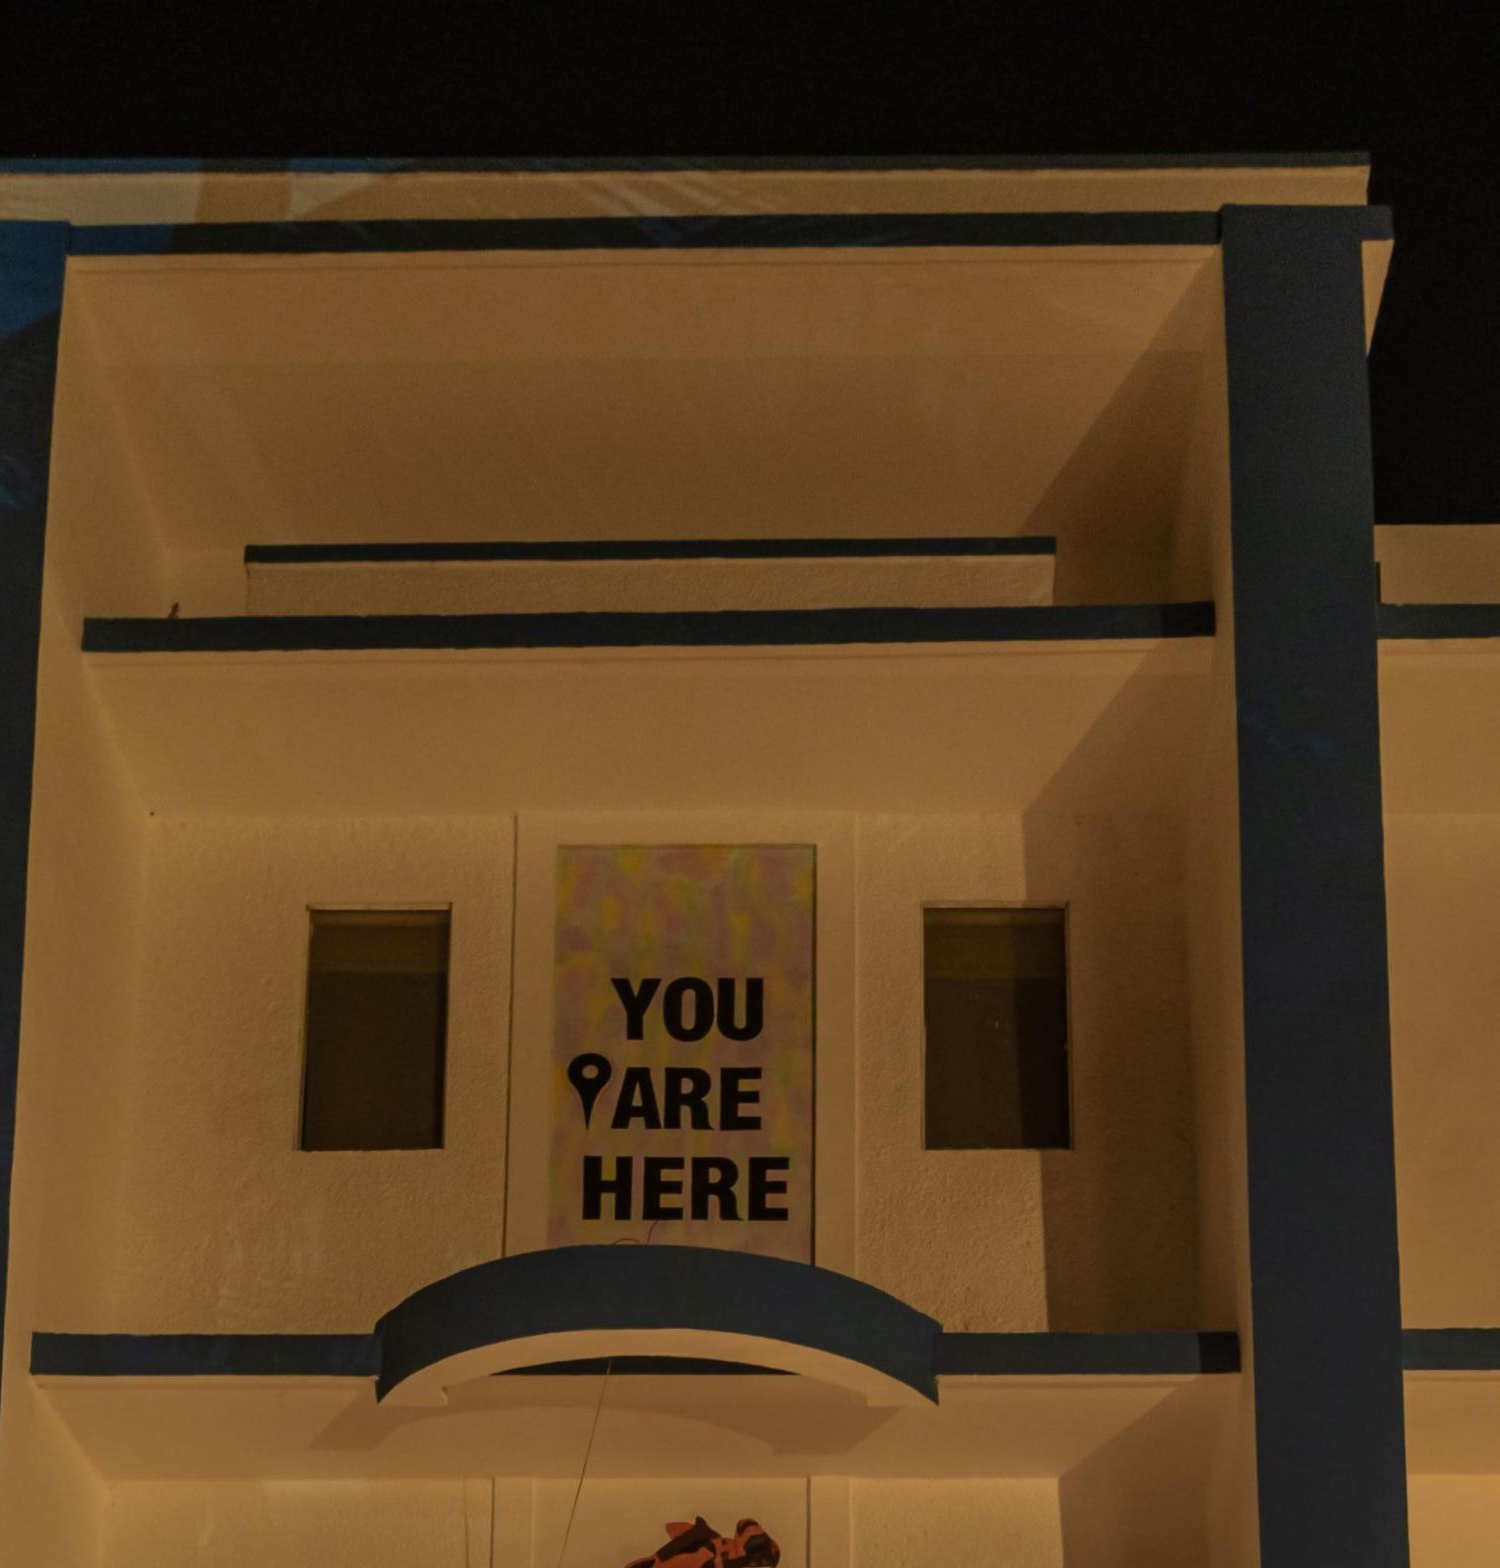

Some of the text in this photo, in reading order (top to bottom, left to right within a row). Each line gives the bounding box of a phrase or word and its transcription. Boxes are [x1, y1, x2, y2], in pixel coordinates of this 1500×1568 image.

[611, 977, 764, 1042] YOU
[610, 1066, 762, 1131] ARE
[582, 1156, 790, 1221] HERE
